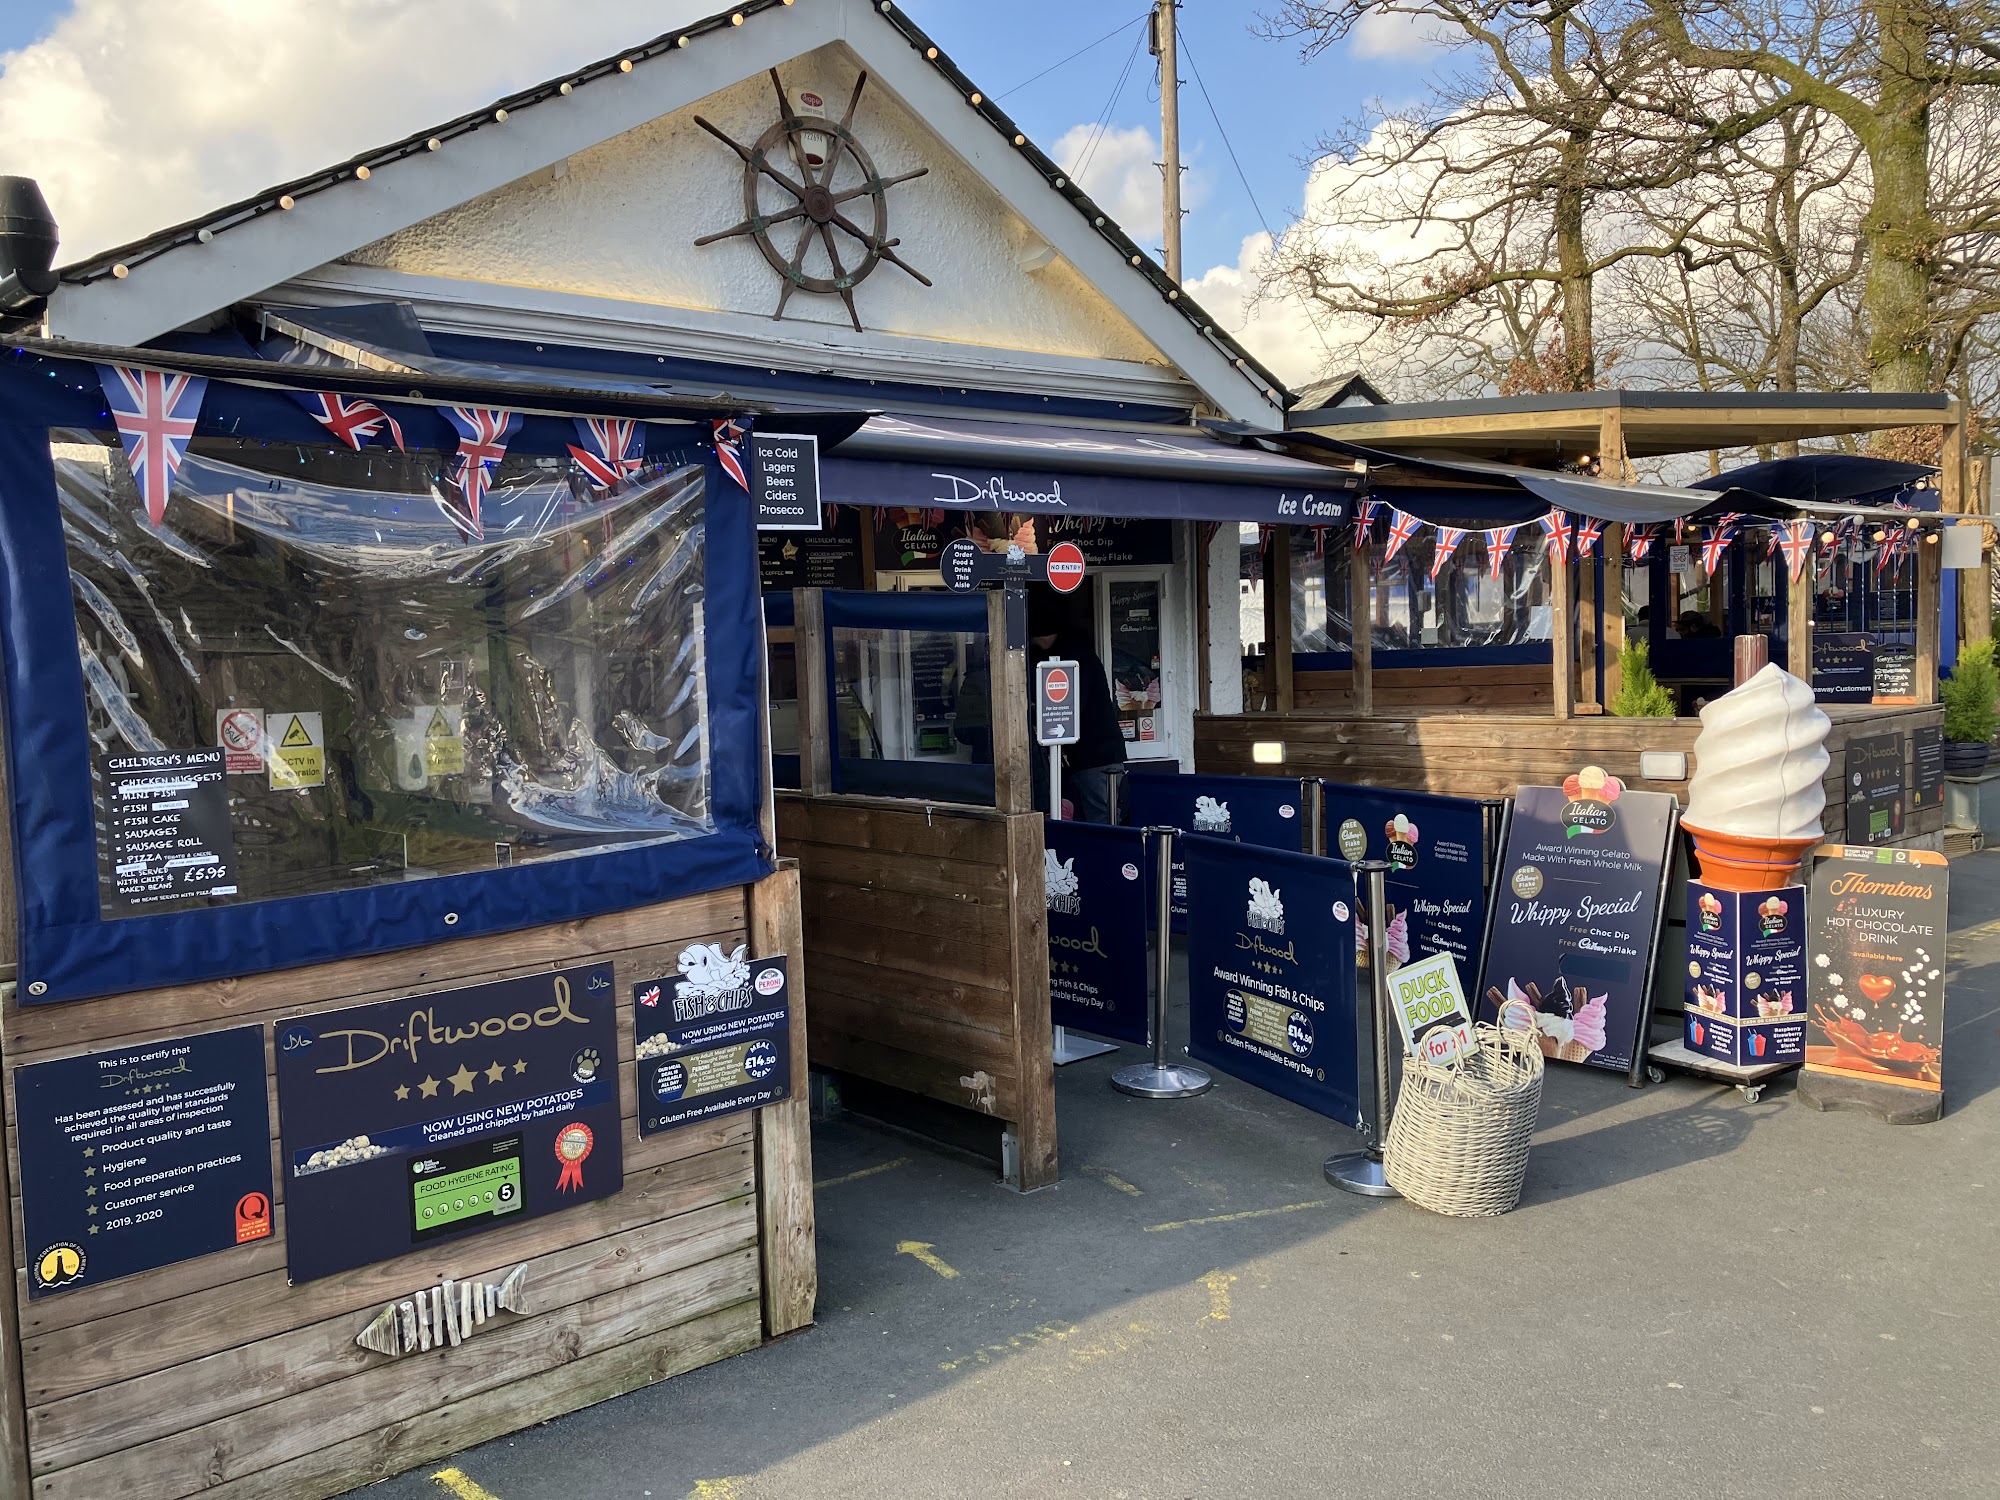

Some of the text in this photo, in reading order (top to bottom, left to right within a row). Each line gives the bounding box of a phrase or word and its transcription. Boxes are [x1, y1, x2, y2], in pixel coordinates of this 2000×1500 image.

[759, 447, 798, 458] Ice Cold
[763, 462, 795, 474] Lagers
[767, 476, 794, 486] Beers
[765, 490, 796, 500] Ciders
[932, 473, 1067, 508] Driftwood
[760, 505, 804, 514] Prosecco
[1278, 494, 1342, 516] Ice Cream
[900, 529, 937, 541] Italian
[109, 754, 181, 768] CHILDREN'S
[187, 752, 220, 763] MENU
[121, 773, 222, 786] CHICKEN NUGGETS
[123, 804, 147, 813] FISH
[1569, 803, 1607, 817] Italian
[124, 814, 181, 826] FISH CAKE
[1573, 817, 1607, 825] GELATO
[125, 827, 177, 839] SAUSAGES
[126, 838, 202, 852] SAUSAGE ROLL
[1536, 844, 1630, 859] Award Winning Gelato
[127, 853, 162, 863] PIZZA
[1522, 852, 1642, 872] Made With Fresh Whole Milk
[117, 875, 164, 886] WITH CHIPS
[184, 866, 226, 882] £5.95
[120, 883, 172, 894] BAKED BEANS
[1830, 872, 1932, 900] Thorntons
[1414, 899, 1472, 916] Whippy Special
[1511, 891, 1642, 925] Whippy Special
[1855, 907, 1905, 920] LUXURY
[1570, 926, 1630, 940] Free Choc Dip
[1827, 917, 1933, 936] HOT CHOCOLATE
[1860, 933, 1898, 944] DRINK
[1236, 932, 1298, 965] Driftwood
[1559, 939, 1637, 955] Free Flake
[1690, 944, 1733, 959] Whippy Special
[1746, 946, 1801, 966] Whippy Special
[1853, 952, 1885, 960] available
[1214, 966, 1324, 1011] Award Winning Fish & Chips
[1399, 968, 1449, 1004] DUCK
[673, 986, 753, 1022] FISH & CHIPS
[1406, 992, 1456, 1028] FOOD
[316, 976, 589, 1074] Driftwood
[682, 1011, 784, 1040] NOW USING NEW POTATOES
[1288, 1025, 1312, 1044] £14.50
[750, 1042, 770, 1053] MEAL
[1225, 1034, 1313, 1076] Gluten Free Available Every Day
[1429, 1039, 1448, 1059] for
[98, 1060, 117, 1069] This
[141, 1050, 170, 1061] certify
[172, 1046, 190, 1055] that
[745, 1055, 775, 1069] £14.50
[100, 1058, 192, 1088] Driftwood
[572, 1072, 596, 1083] Welcome
[752, 1067, 771, 1078] DEAL
[55, 1082, 236, 1124] Has been assessed and has successfully
[423, 1088, 583, 1134] NOW USING NEW POTATOES
[660, 1090, 771, 1125] Gluten Free Available Every Day
[64, 1093, 228, 1133] achieved the quality level standards
[72, 1129, 112, 1143] required
[126, 1122, 137, 1131] all
[140, 1118, 164, 1127] areas
[166, 1114, 175, 1122] of
[177, 1105, 223, 1119] inspection
[429, 1102, 575, 1142] Cleaned and chipped by hand daily
[102, 1119, 231, 1153] Product quality and taste
[103, 1157, 146, 1173] Hygiene
[104, 1154, 241, 1191] Food preparation practices
[420, 1163, 514, 1193] FOOD HYGIENE RATING
[105, 1183, 195, 1211] Customer service
[501, 1186, 511, 1199] 5
[136, 1209, 163, 1223] 2020
